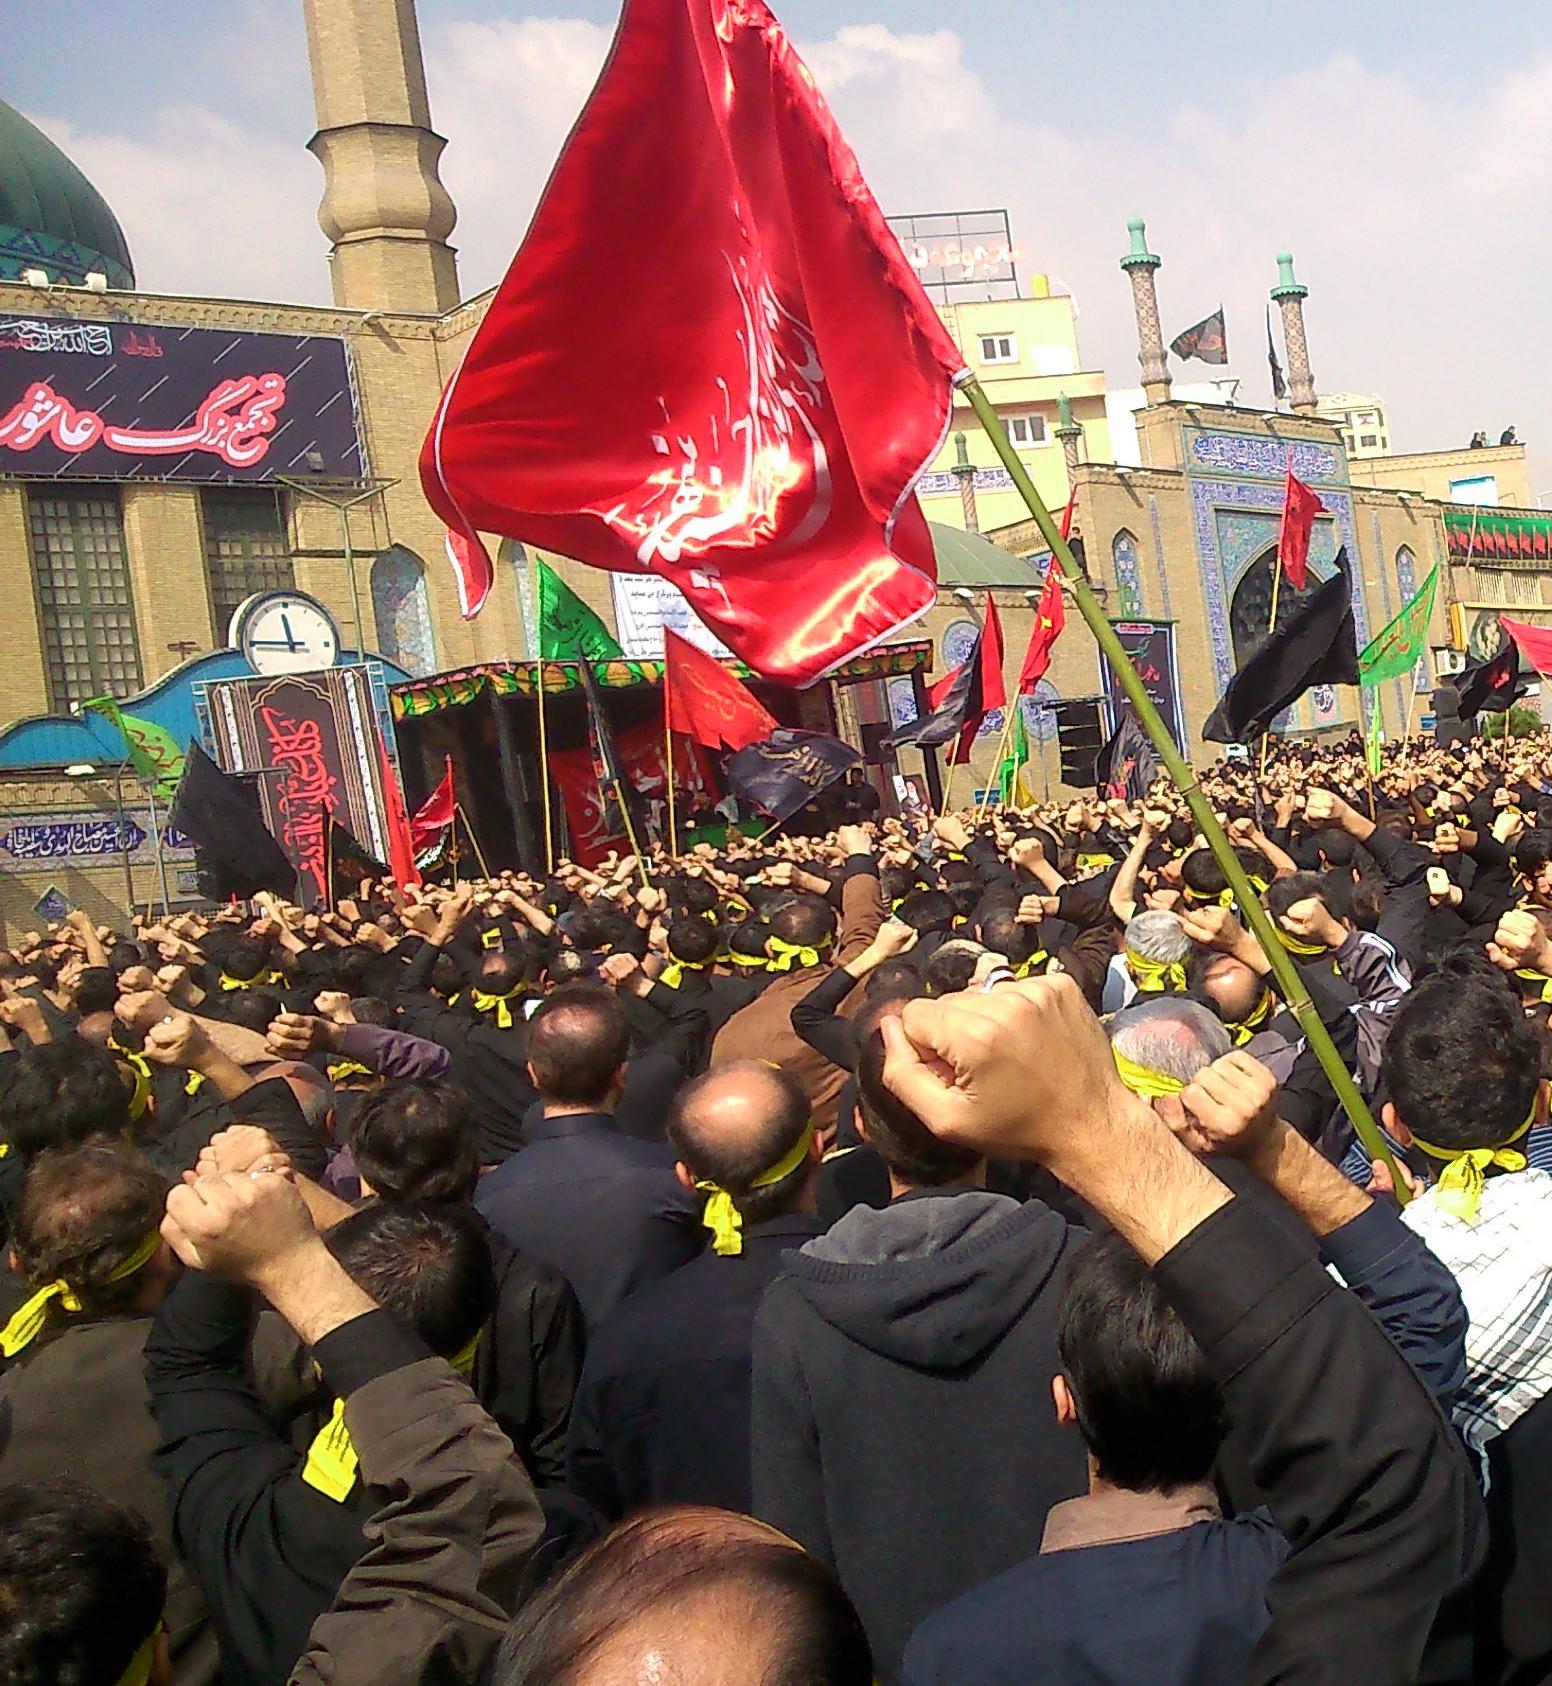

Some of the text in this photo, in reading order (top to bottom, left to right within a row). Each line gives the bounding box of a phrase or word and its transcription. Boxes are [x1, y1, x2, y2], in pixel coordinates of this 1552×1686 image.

[0, 377, 278, 462] تجمع بزرگ عاشور
